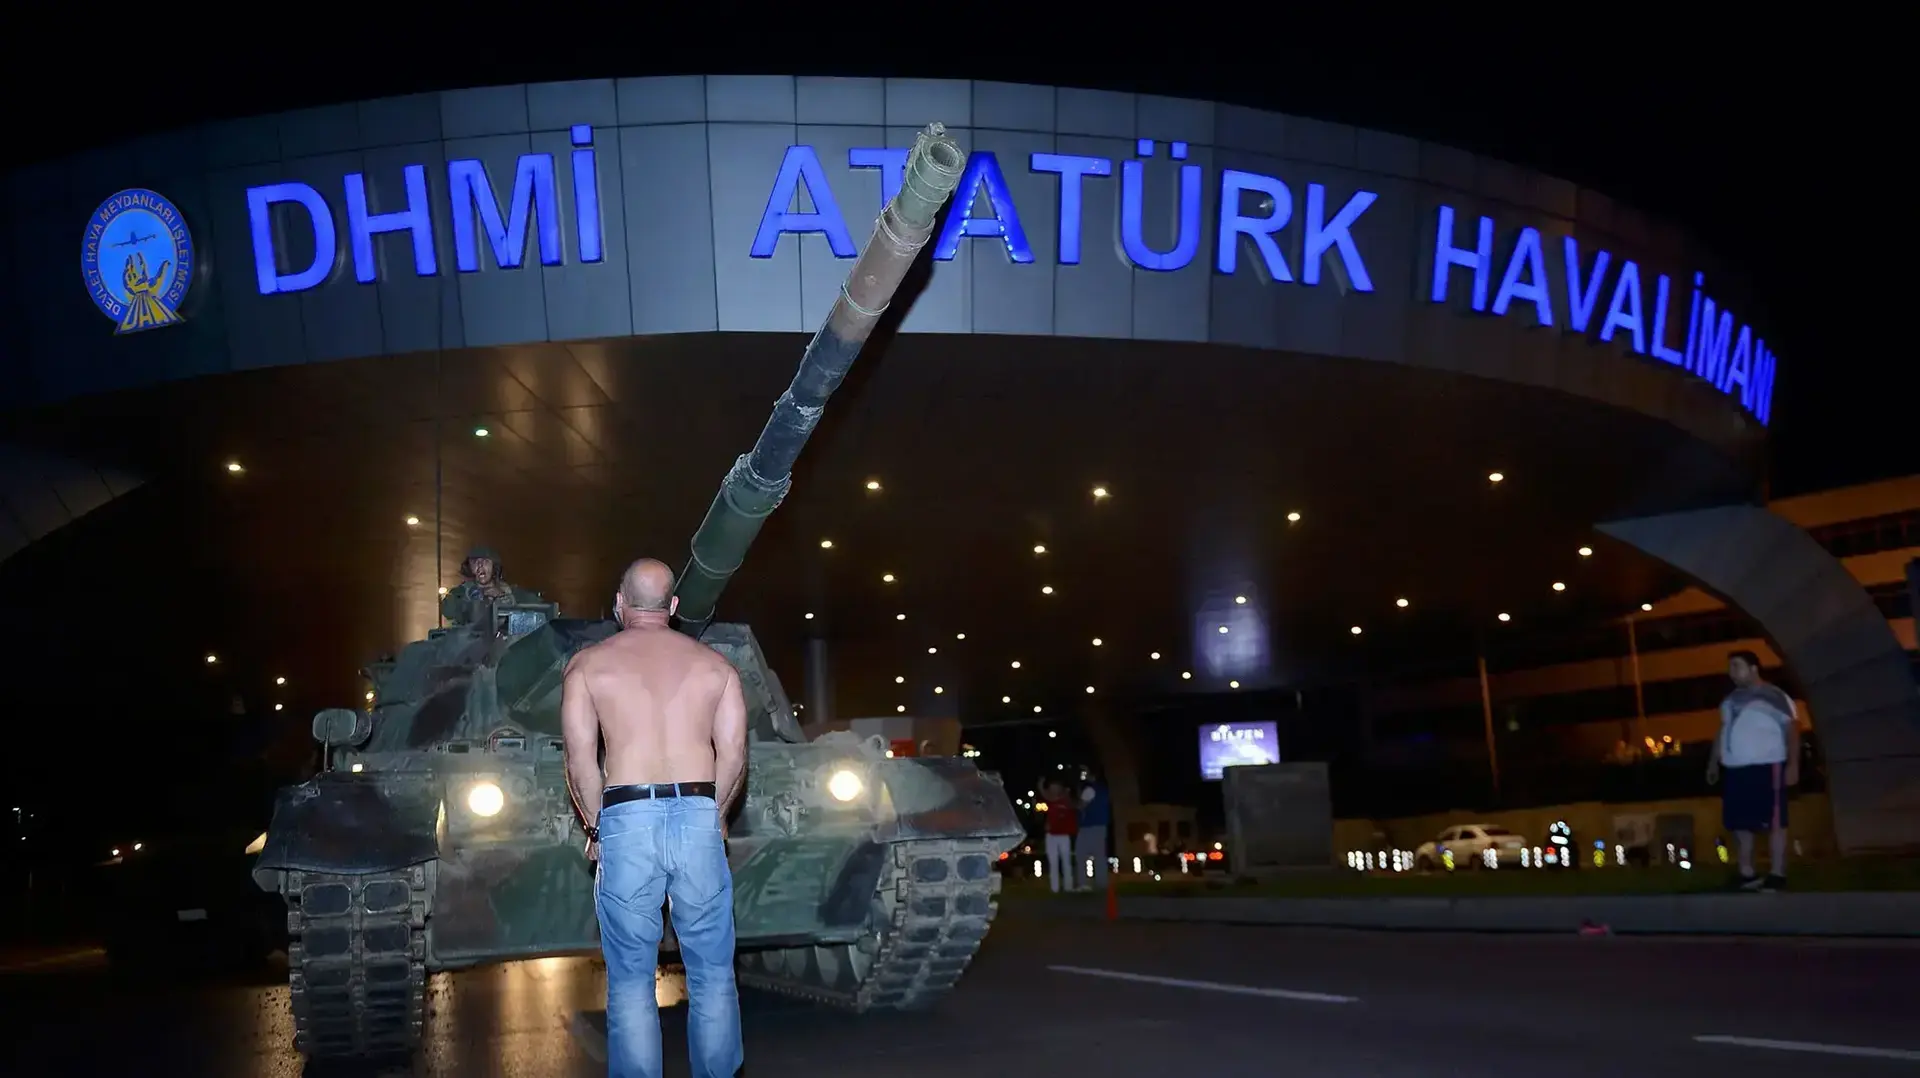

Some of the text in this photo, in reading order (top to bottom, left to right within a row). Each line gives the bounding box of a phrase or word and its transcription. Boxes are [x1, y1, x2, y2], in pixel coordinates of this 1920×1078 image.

[100, 194, 176, 225] MEYDANLARI
[749, 138, 1379, 293] ATATÜRK
[86, 222, 103, 262] HAVA
[87, 269, 121, 316] DEVLET
